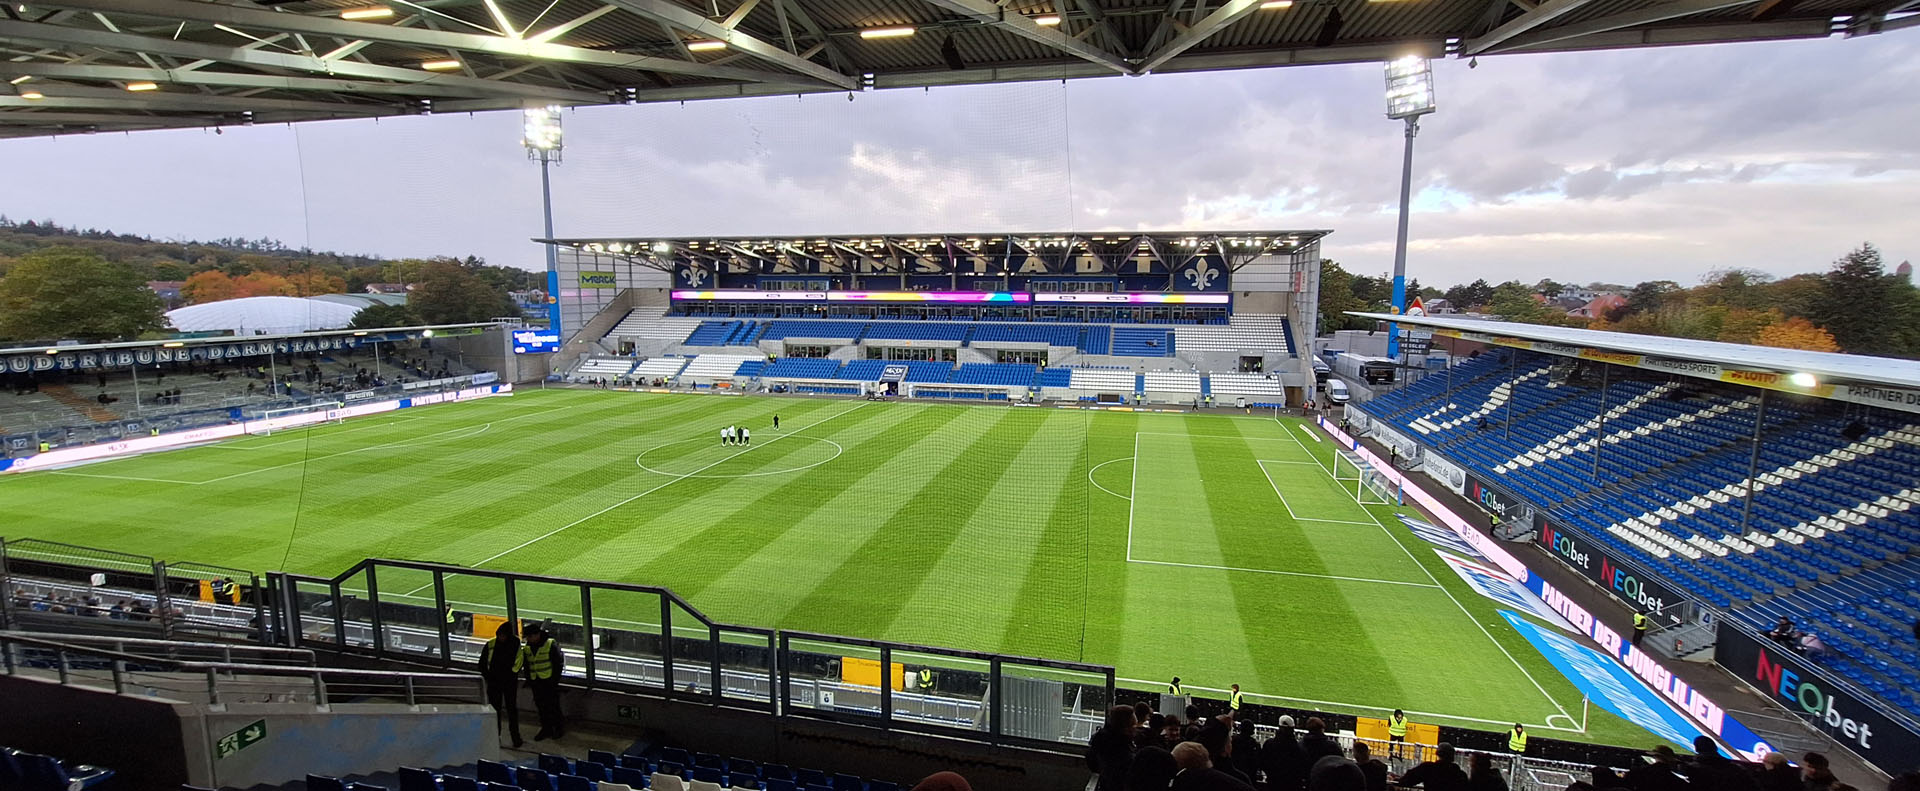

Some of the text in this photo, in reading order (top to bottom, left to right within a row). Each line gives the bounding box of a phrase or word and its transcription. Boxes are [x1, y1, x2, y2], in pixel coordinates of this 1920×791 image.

[581, 275, 616, 284] MERCK
[208, 338, 342, 359] DARMSTADT
[1688, 362, 1717, 375] SPORTS
[1744, 372, 1777, 384] LOTTO
[1848, 385, 1903, 403] PARTNER
[1542, 580, 1725, 737] PARTNER DER JUNGLILIEN
